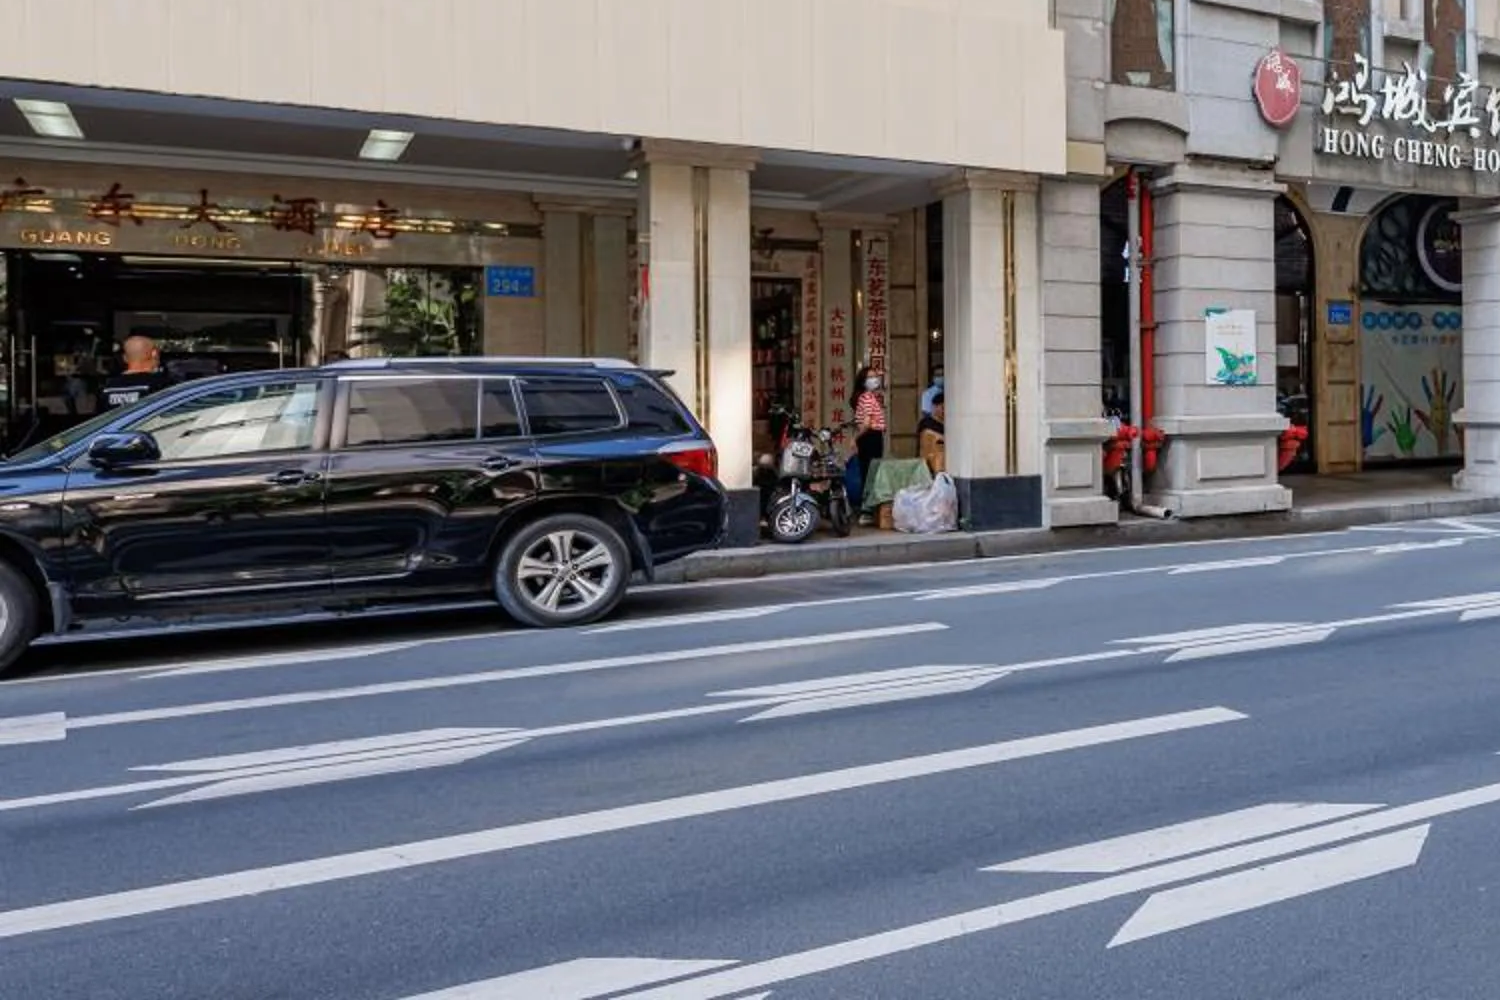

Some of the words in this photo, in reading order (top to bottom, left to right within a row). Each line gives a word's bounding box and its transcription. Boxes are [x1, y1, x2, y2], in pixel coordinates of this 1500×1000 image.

[1323, 128, 1385, 159] HONG
[1393, 138, 1462, 169] CHENG
[20, 230, 112, 246] GUANG
